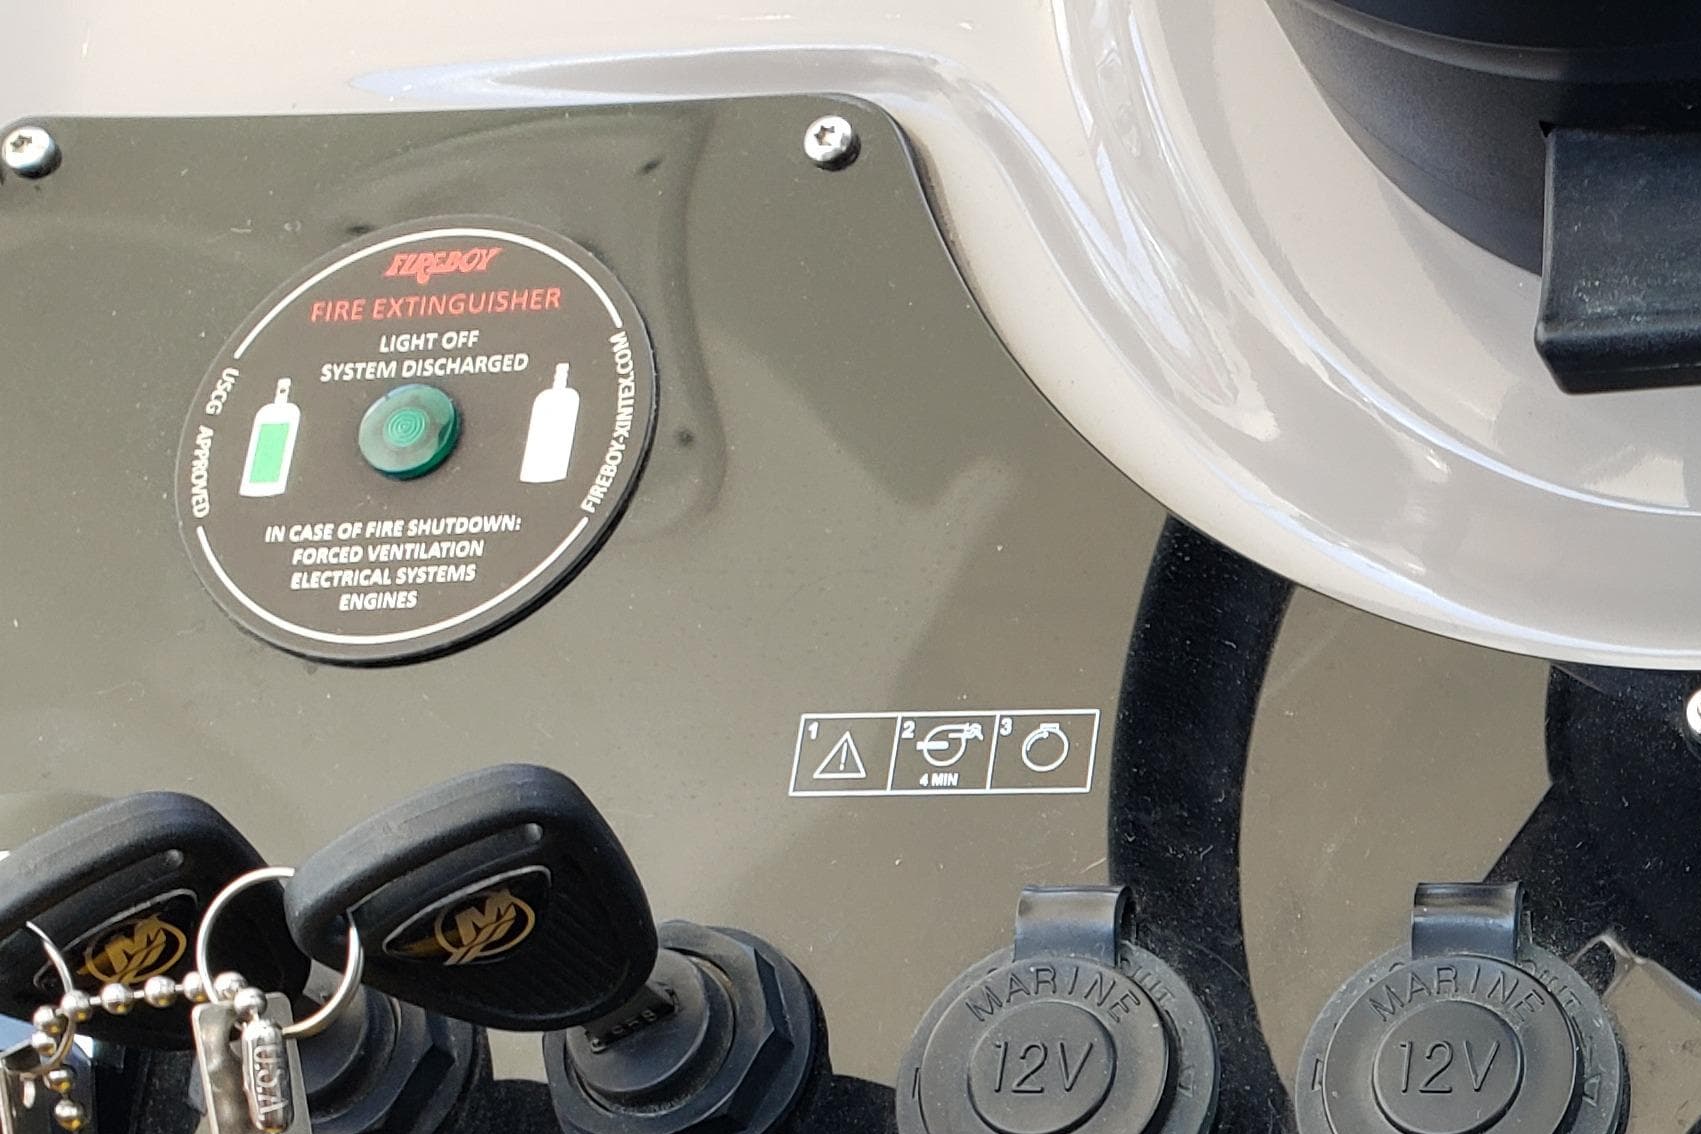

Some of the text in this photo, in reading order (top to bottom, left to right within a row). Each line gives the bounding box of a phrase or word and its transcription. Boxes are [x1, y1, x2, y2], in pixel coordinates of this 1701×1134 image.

[384, 247, 503, 284] FIREBOY
[310, 287, 562, 322] FIRE EXTINGUISHER
[378, 329, 480, 353] LIGHT OFF
[319, 353, 529, 382] SYSTEM DISCHARGED
[191, 367, 240, 518] USCG APPROVED
[264, 515, 522, 542] IN CASE OF FIRE SHUTDOWN:
[292, 540, 485, 565] FORCED VENTILATION
[290, 564, 476, 590] ELECTRICAL SYSTEMS
[339, 591, 418, 611] ENGINES
[919, 773, 959, 787] 4 MIN
[965, 966, 1141, 1024] MARINE
[1370, 964, 1546, 1024] MARINE
[994, 1041, 1093, 1094] 12V
[1400, 1040, 1500, 1094] 12V
